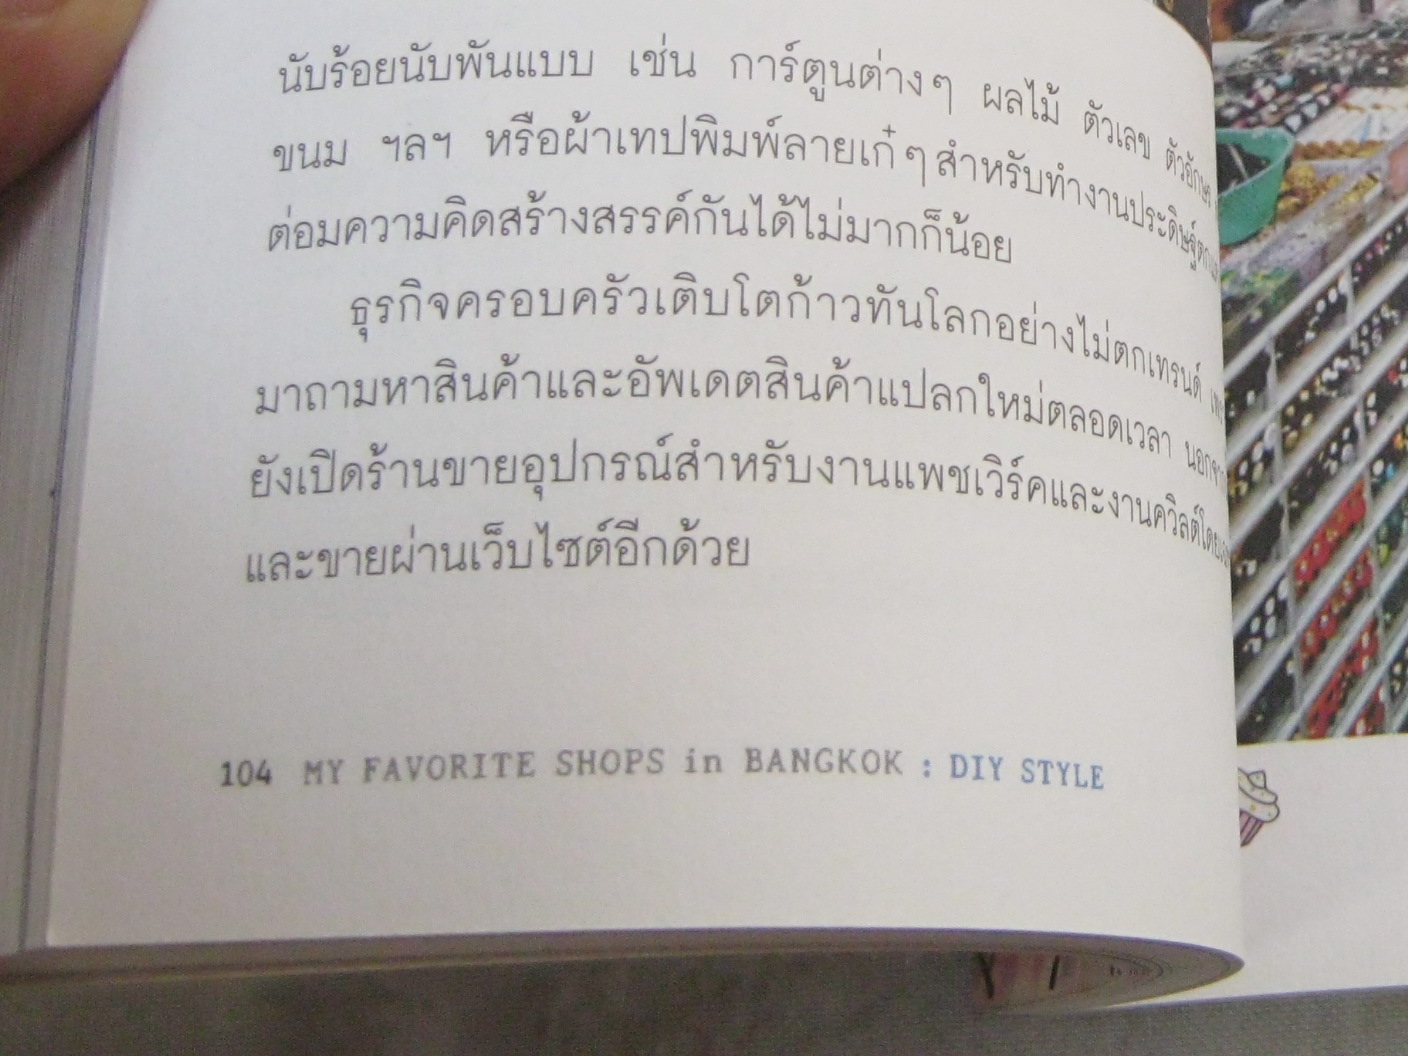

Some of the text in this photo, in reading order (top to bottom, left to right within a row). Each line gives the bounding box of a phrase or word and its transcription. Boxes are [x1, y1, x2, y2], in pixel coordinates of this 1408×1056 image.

[278, 38, 595, 94] นับร้อยนับพันแบบ
[629, 32, 697, 79] เช่น
[731, 39, 953, 115] การ์ตูนต่างๆ
[983, 76, 1060, 126] ผลไม้
[1083, 99, 1151, 160] ตัวเลข
[272, 137, 348, 173] ขนม
[382, 130, 452, 162] ฯลฯ
[267, 188, 1013, 264] ต่อมความคิดสร้างสรรค์กันได้ไม่มากก็น้อย
[350, 271, 1202, 402] ธุรกิจครอบครัวเติบโตก้าวทันโลกอย่างไม่ตกเทรนด์
[255, 352, 1172, 457] มาถามหาสินค้าและอัพเดตสินค้าแปลกใหม่ตลอดเวลา
[245, 517, 750, 584] และขายผ่านเว็บไซต์อีกด้วย
[220, 758, 273, 787] 104
[303, 758, 345, 786] MY
[362, 750, 536, 784] FAVORITE
[555, 747, 666, 777] SHOPS
[684, 747, 723, 774] in
[744, 747, 904, 775] BANGKOK
[950, 753, 1004, 782] DIY
[1020, 757, 1105, 790] STYLE
